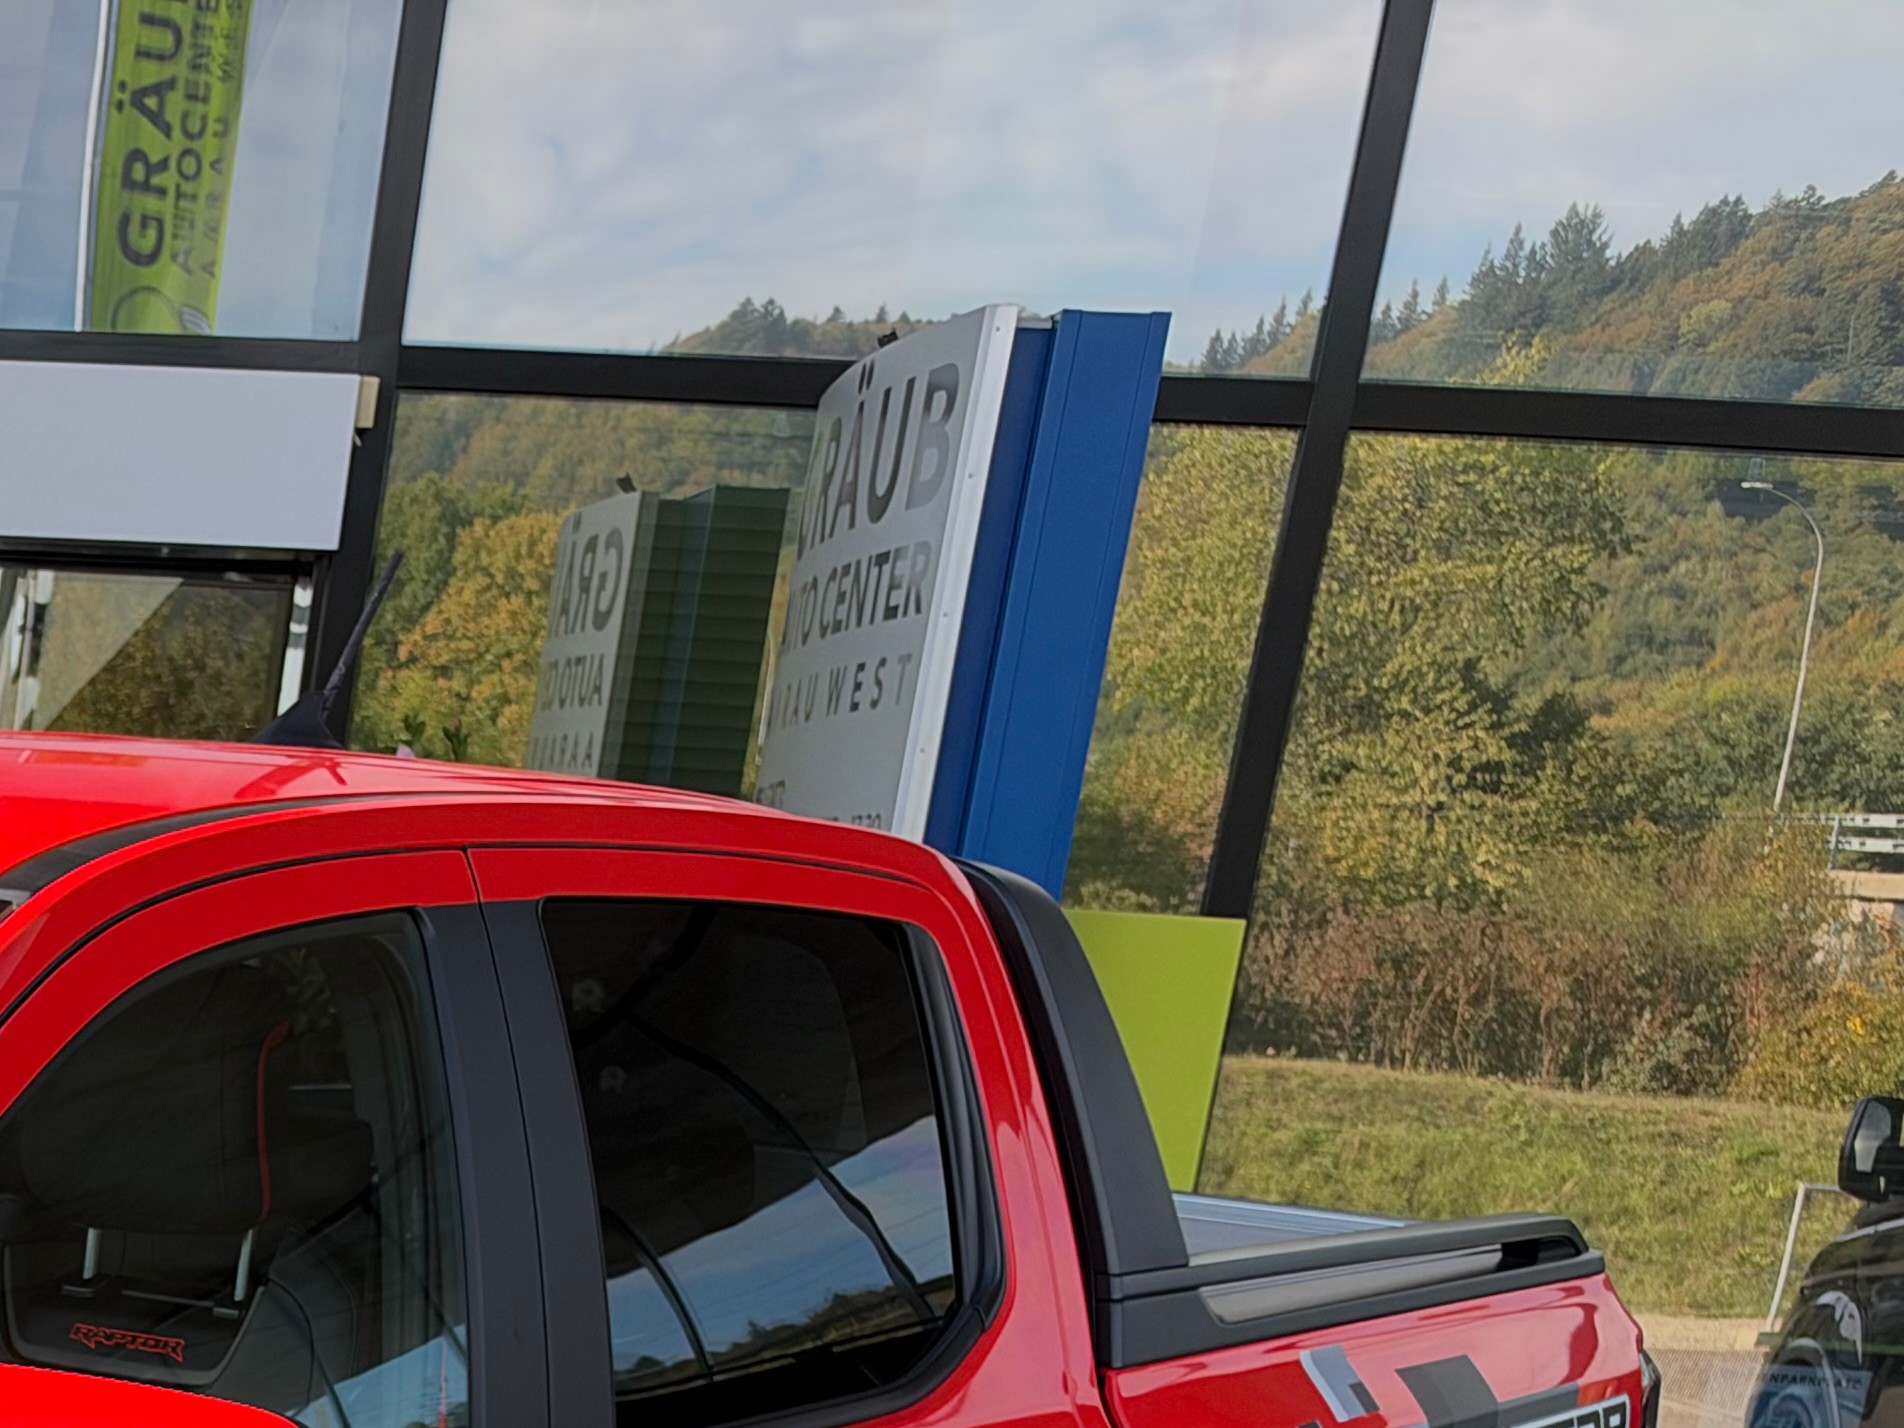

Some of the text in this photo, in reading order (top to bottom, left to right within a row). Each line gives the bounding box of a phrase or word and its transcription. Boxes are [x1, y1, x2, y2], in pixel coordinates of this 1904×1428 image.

[115, 0, 185, 269] GRÄU
[826, 652, 913, 718] WEST
[69, 1322, 185, 1362] RAPTOR
